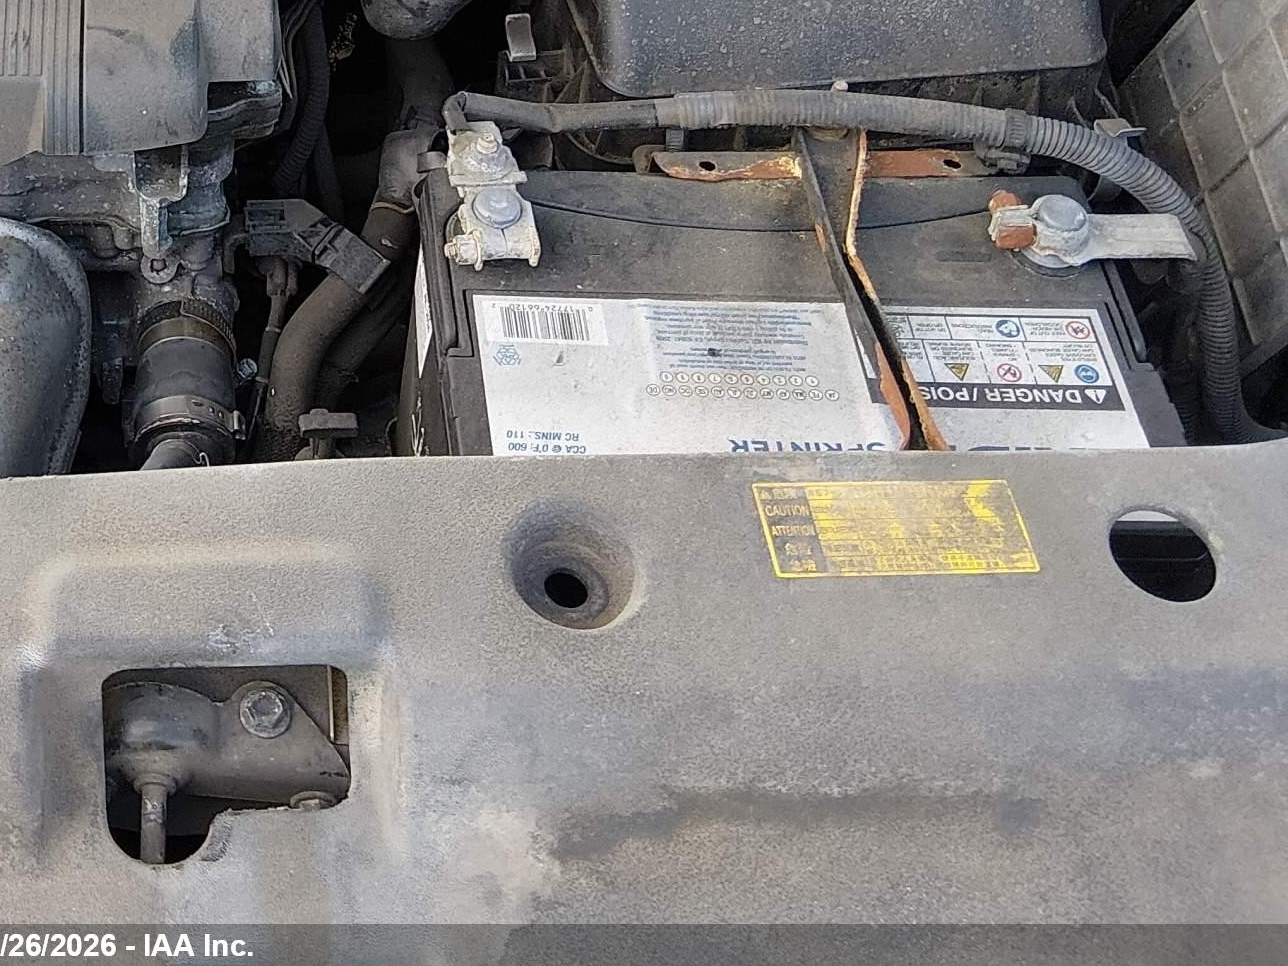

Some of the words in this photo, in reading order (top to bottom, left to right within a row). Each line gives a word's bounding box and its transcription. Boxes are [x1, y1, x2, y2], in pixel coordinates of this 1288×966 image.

[971, 387, 978, 402] /
[983, 387, 1083, 404] DANGER
[506, 429, 525, 440] 110
[564, 432, 580, 442] RC
[507, 442, 528, 452] 600
[551, 444, 562, 454] @
[565, 444, 587, 454] CCA
[764, 505, 810, 517] CAUTION
[771, 524, 816, 537] ATTENTION
